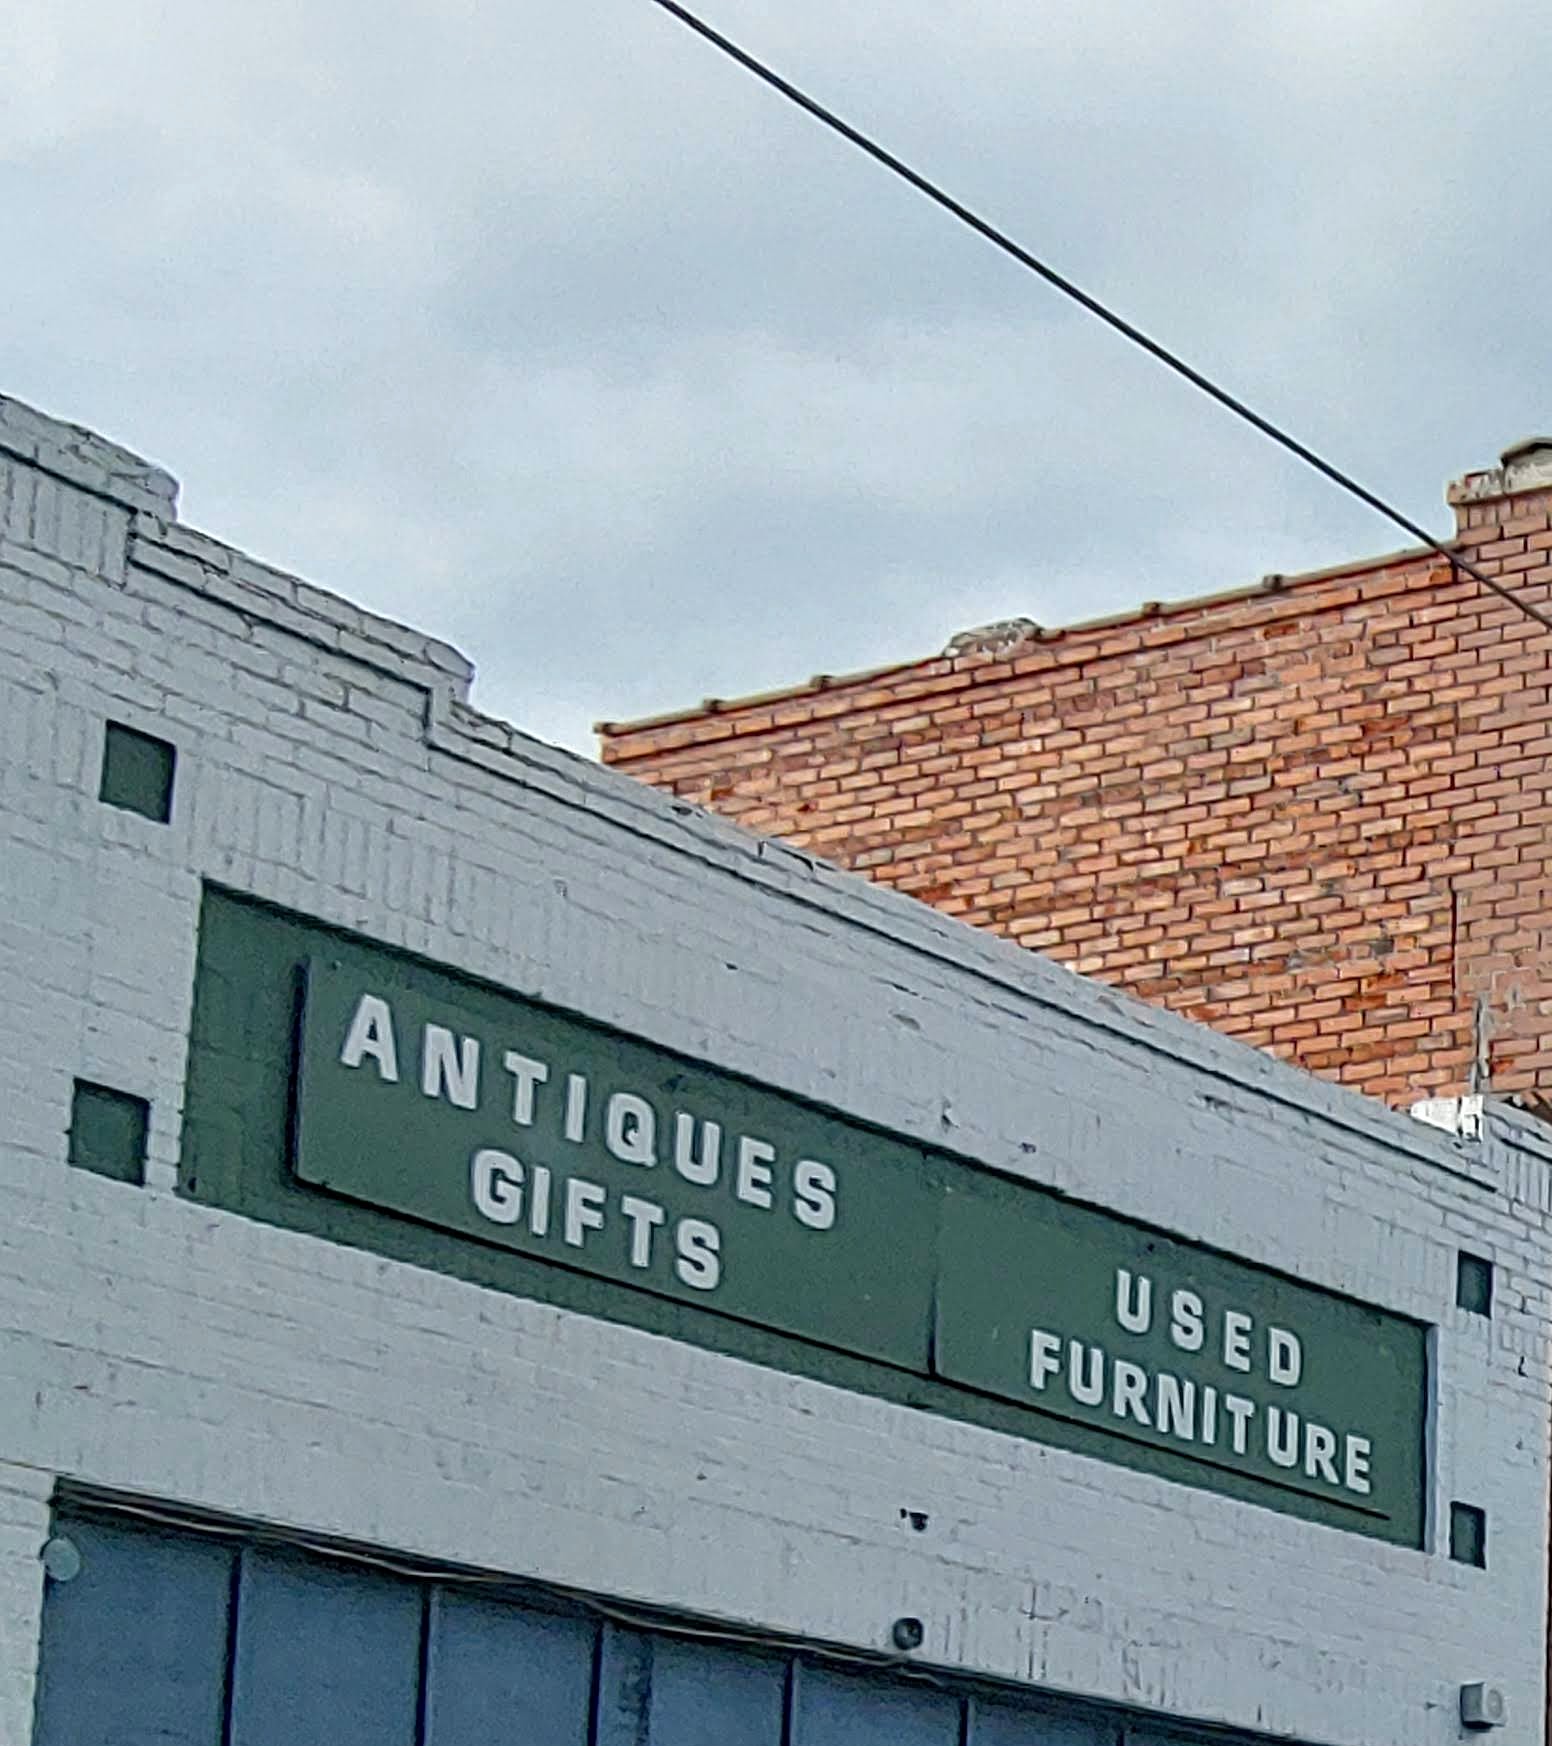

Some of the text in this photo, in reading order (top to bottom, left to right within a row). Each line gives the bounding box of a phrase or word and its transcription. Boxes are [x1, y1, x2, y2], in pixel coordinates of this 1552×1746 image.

[340, 993, 838, 1231] ANTIQUES
[471, 1148, 721, 1291] GIFTS
[1116, 1269, 1302, 1388] USED
[1029, 1328, 1372, 1495] FURNITURE
